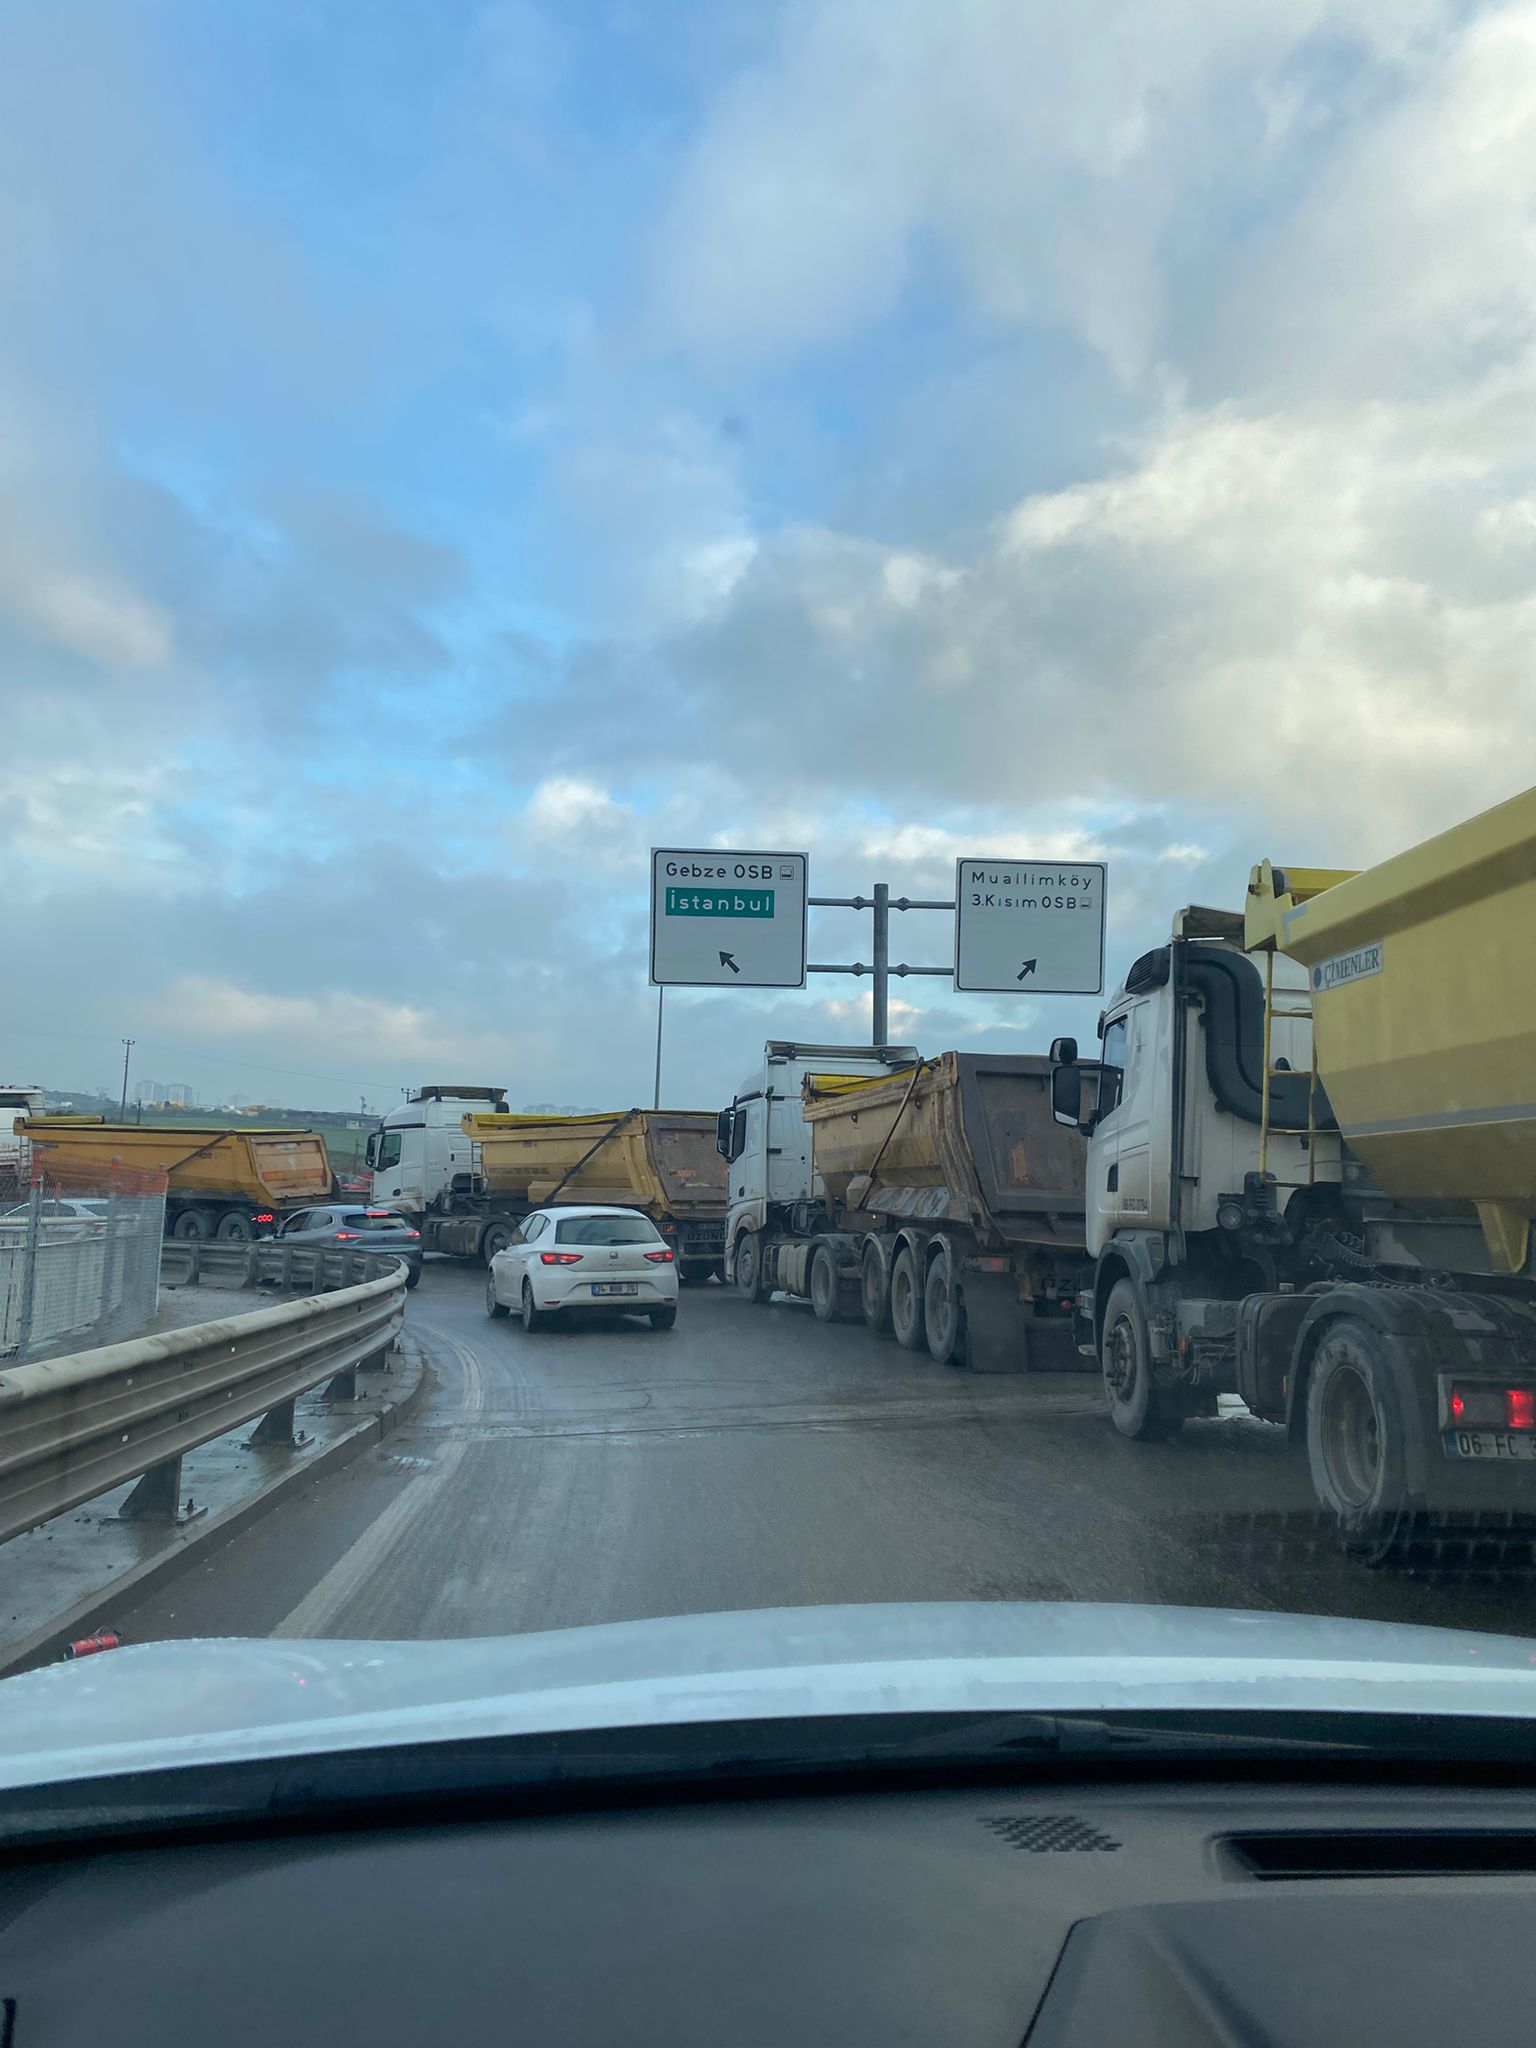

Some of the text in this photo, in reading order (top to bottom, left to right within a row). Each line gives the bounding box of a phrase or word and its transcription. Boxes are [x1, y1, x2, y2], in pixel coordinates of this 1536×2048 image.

[666, 862, 773, 880] Gebze OSB
[971, 871, 1092, 891] Muallimköy
[1041, 895, 1077, 910] OSB
[1459, 1434, 1481, 1456] 06
[1495, 1435, 1519, 1456] FC
